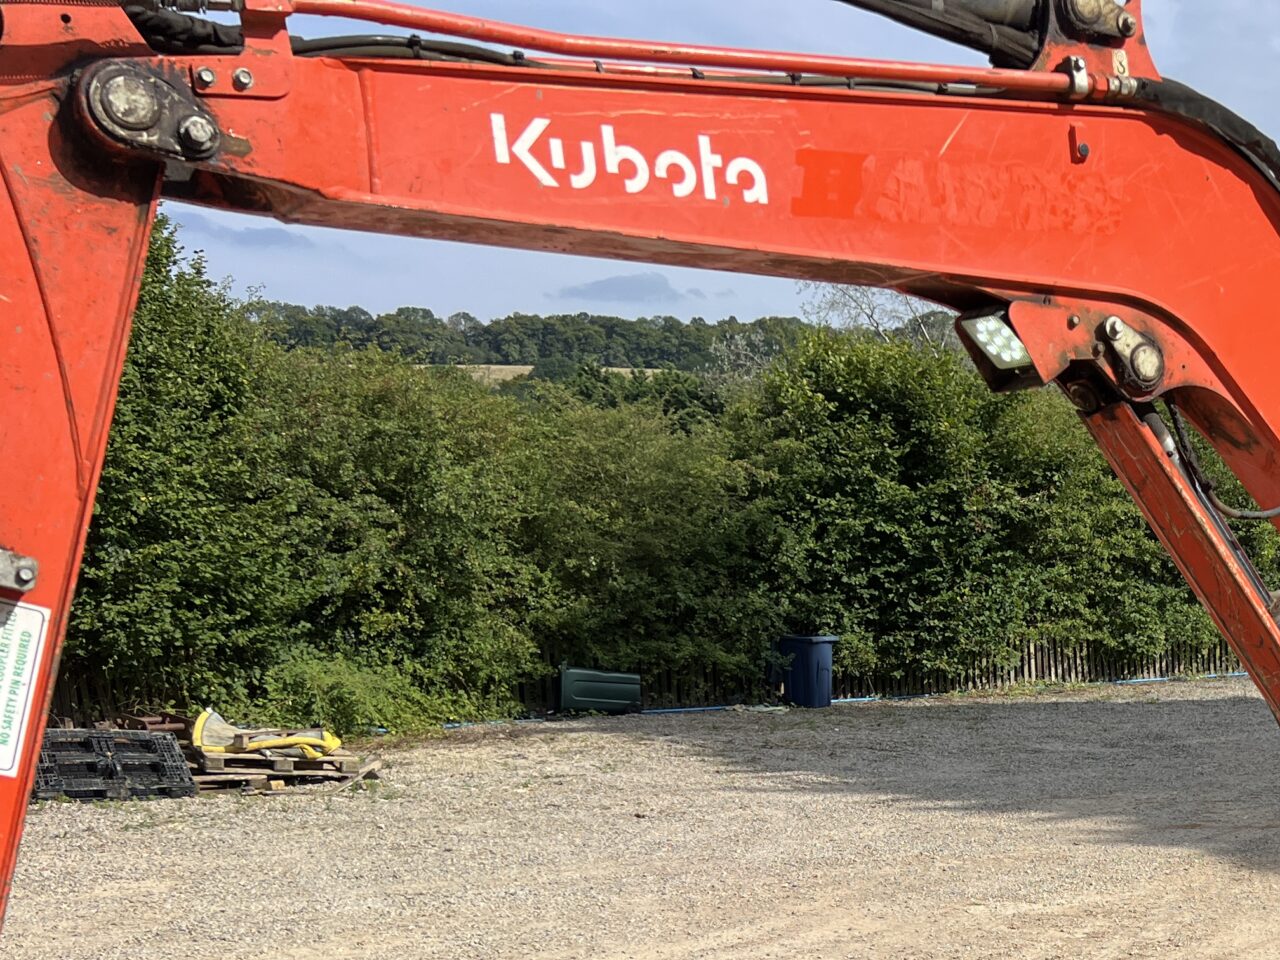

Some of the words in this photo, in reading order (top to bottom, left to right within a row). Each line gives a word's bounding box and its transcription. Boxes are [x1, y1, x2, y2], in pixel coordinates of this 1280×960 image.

[490, 112, 769, 205] Kubota
[12, 630, 33, 678] REQUIRED
[8, 678, 22, 696] PIN
[1, 696, 17, 731] SAFETY
[0, 733, 10, 746] NO
